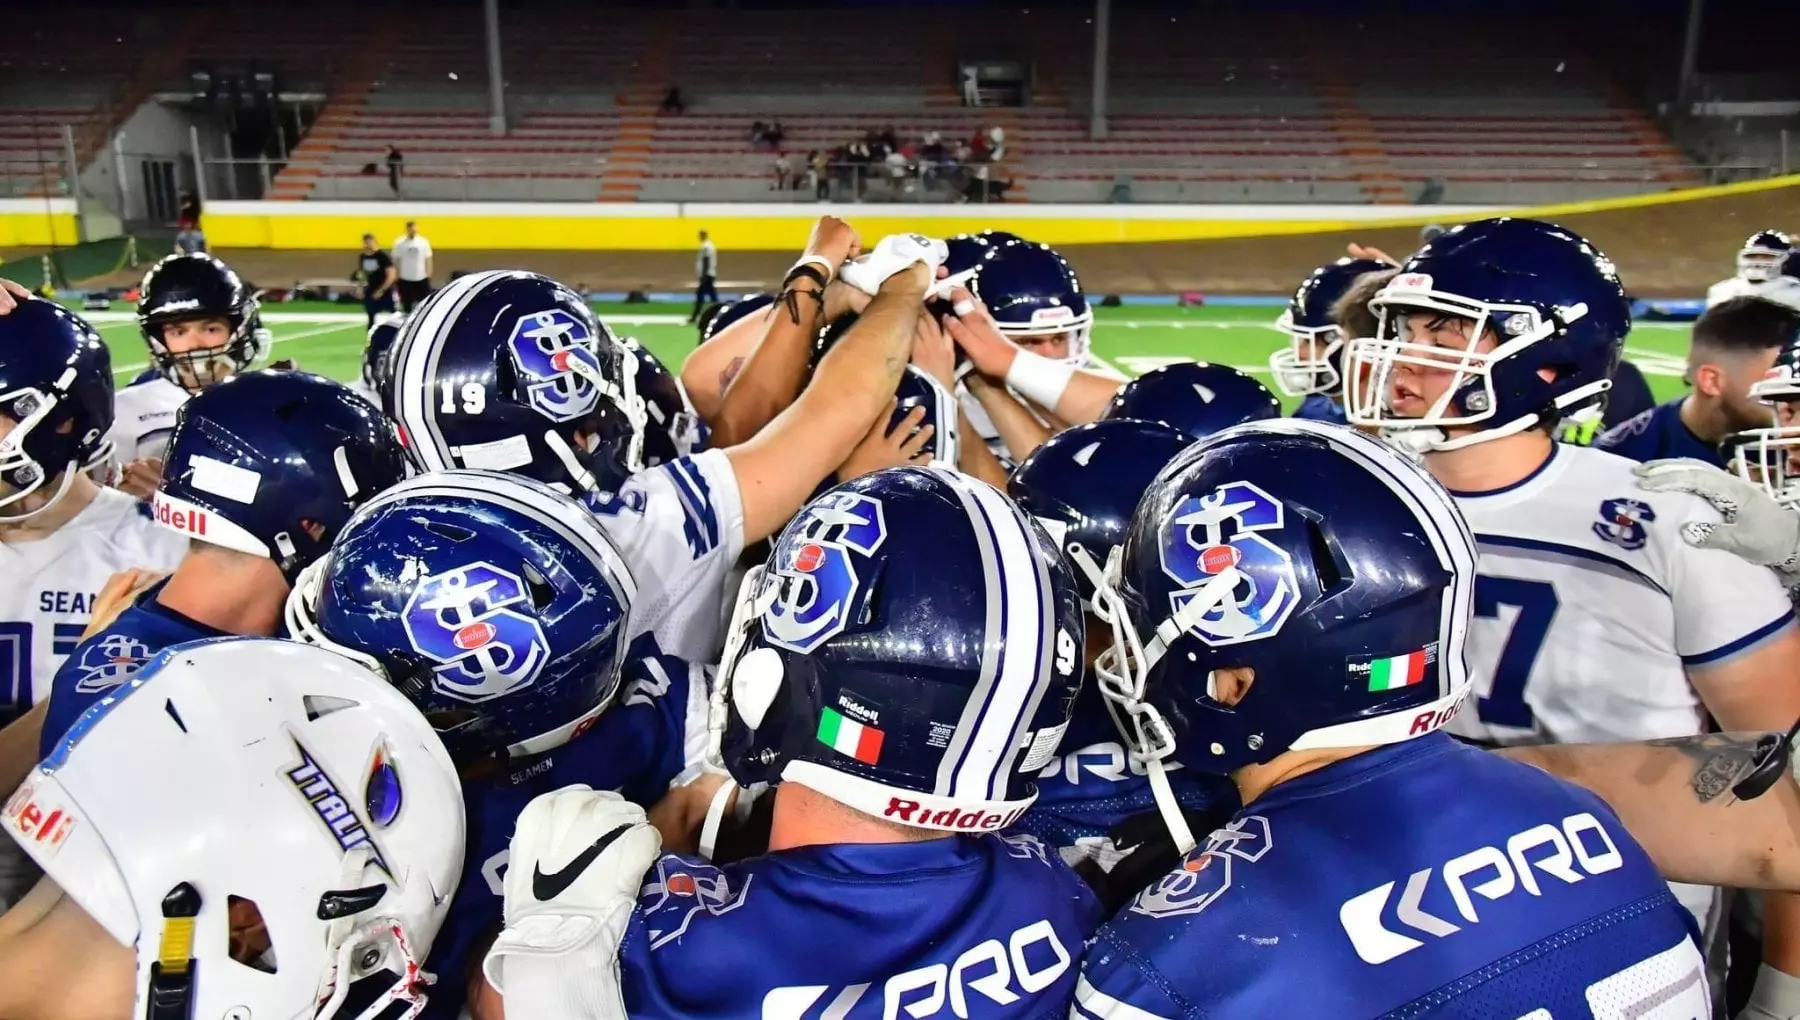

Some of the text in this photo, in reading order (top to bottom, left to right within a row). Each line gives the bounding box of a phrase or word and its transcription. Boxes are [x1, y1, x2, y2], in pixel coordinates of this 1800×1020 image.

[440, 381, 486, 414] 19
[1055, 627, 1076, 676] 9
[1474, 574, 1562, 730] 7
[838, 695, 880, 722] Riddell
[510, 757, 554, 785] SEAMEN
[884, 797, 1026, 829] Riddell
